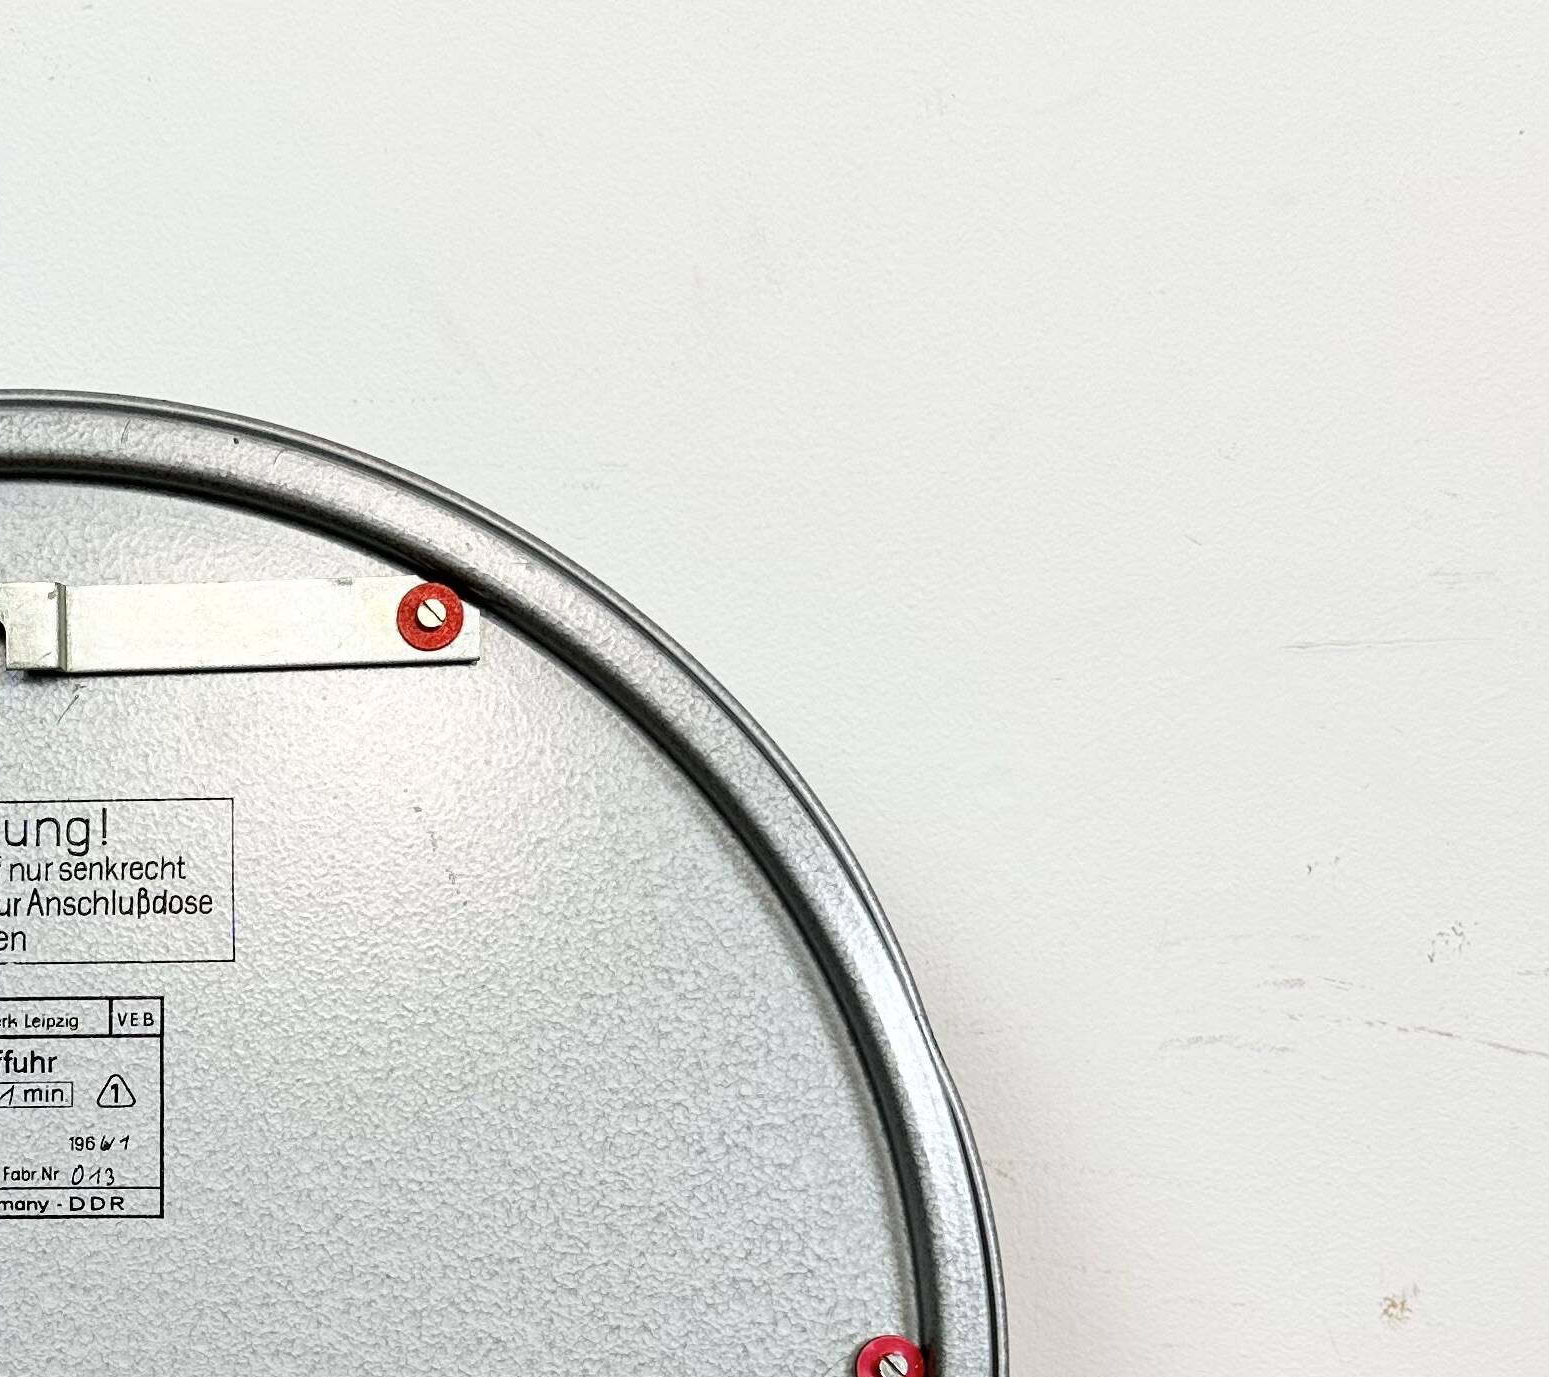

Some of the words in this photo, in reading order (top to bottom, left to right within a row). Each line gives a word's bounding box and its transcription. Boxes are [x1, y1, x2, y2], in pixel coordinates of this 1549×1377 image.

[10, 860, 53, 883] nur
[59, 855, 187, 882] senkrecht
[27, 887, 213, 919] Anschlußdose
[24, 1013, 79, 1031] Leipzig
